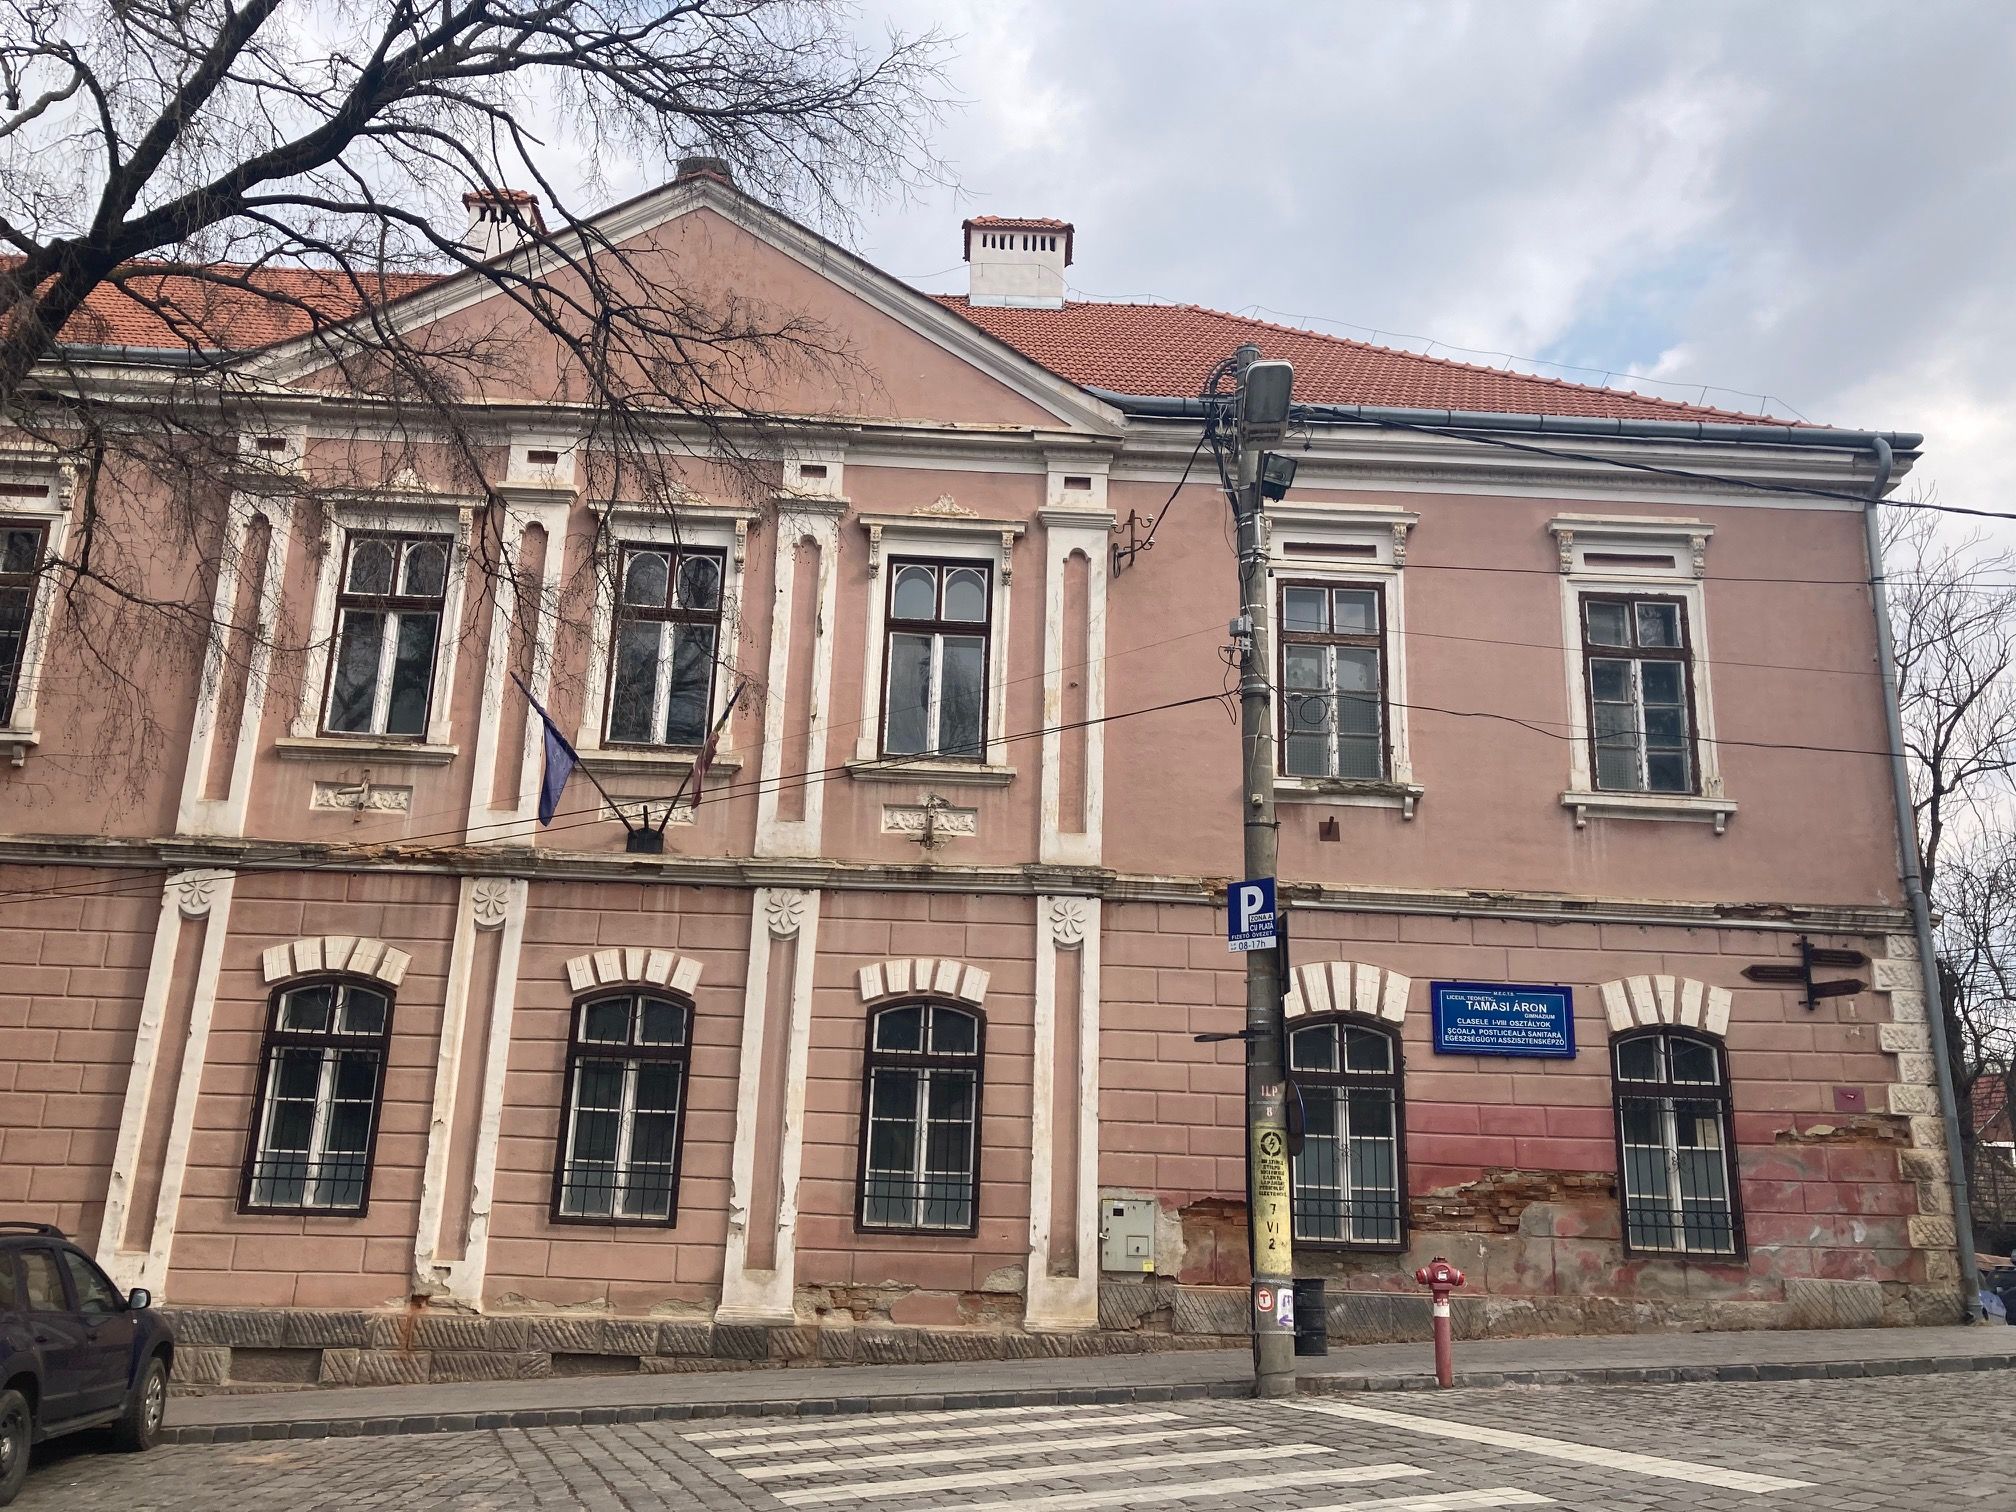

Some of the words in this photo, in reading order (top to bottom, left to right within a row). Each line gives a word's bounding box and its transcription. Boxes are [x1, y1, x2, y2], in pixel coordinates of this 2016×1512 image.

[1240, 886, 1264, 932] P
[1466, 1001, 1510, 1011] TAMÁSI
[1512, 1000, 1546, 1012] ÁRON
[1270, 1204, 1276, 1214] 7
[1268, 1239, 1276, 1249] 2
